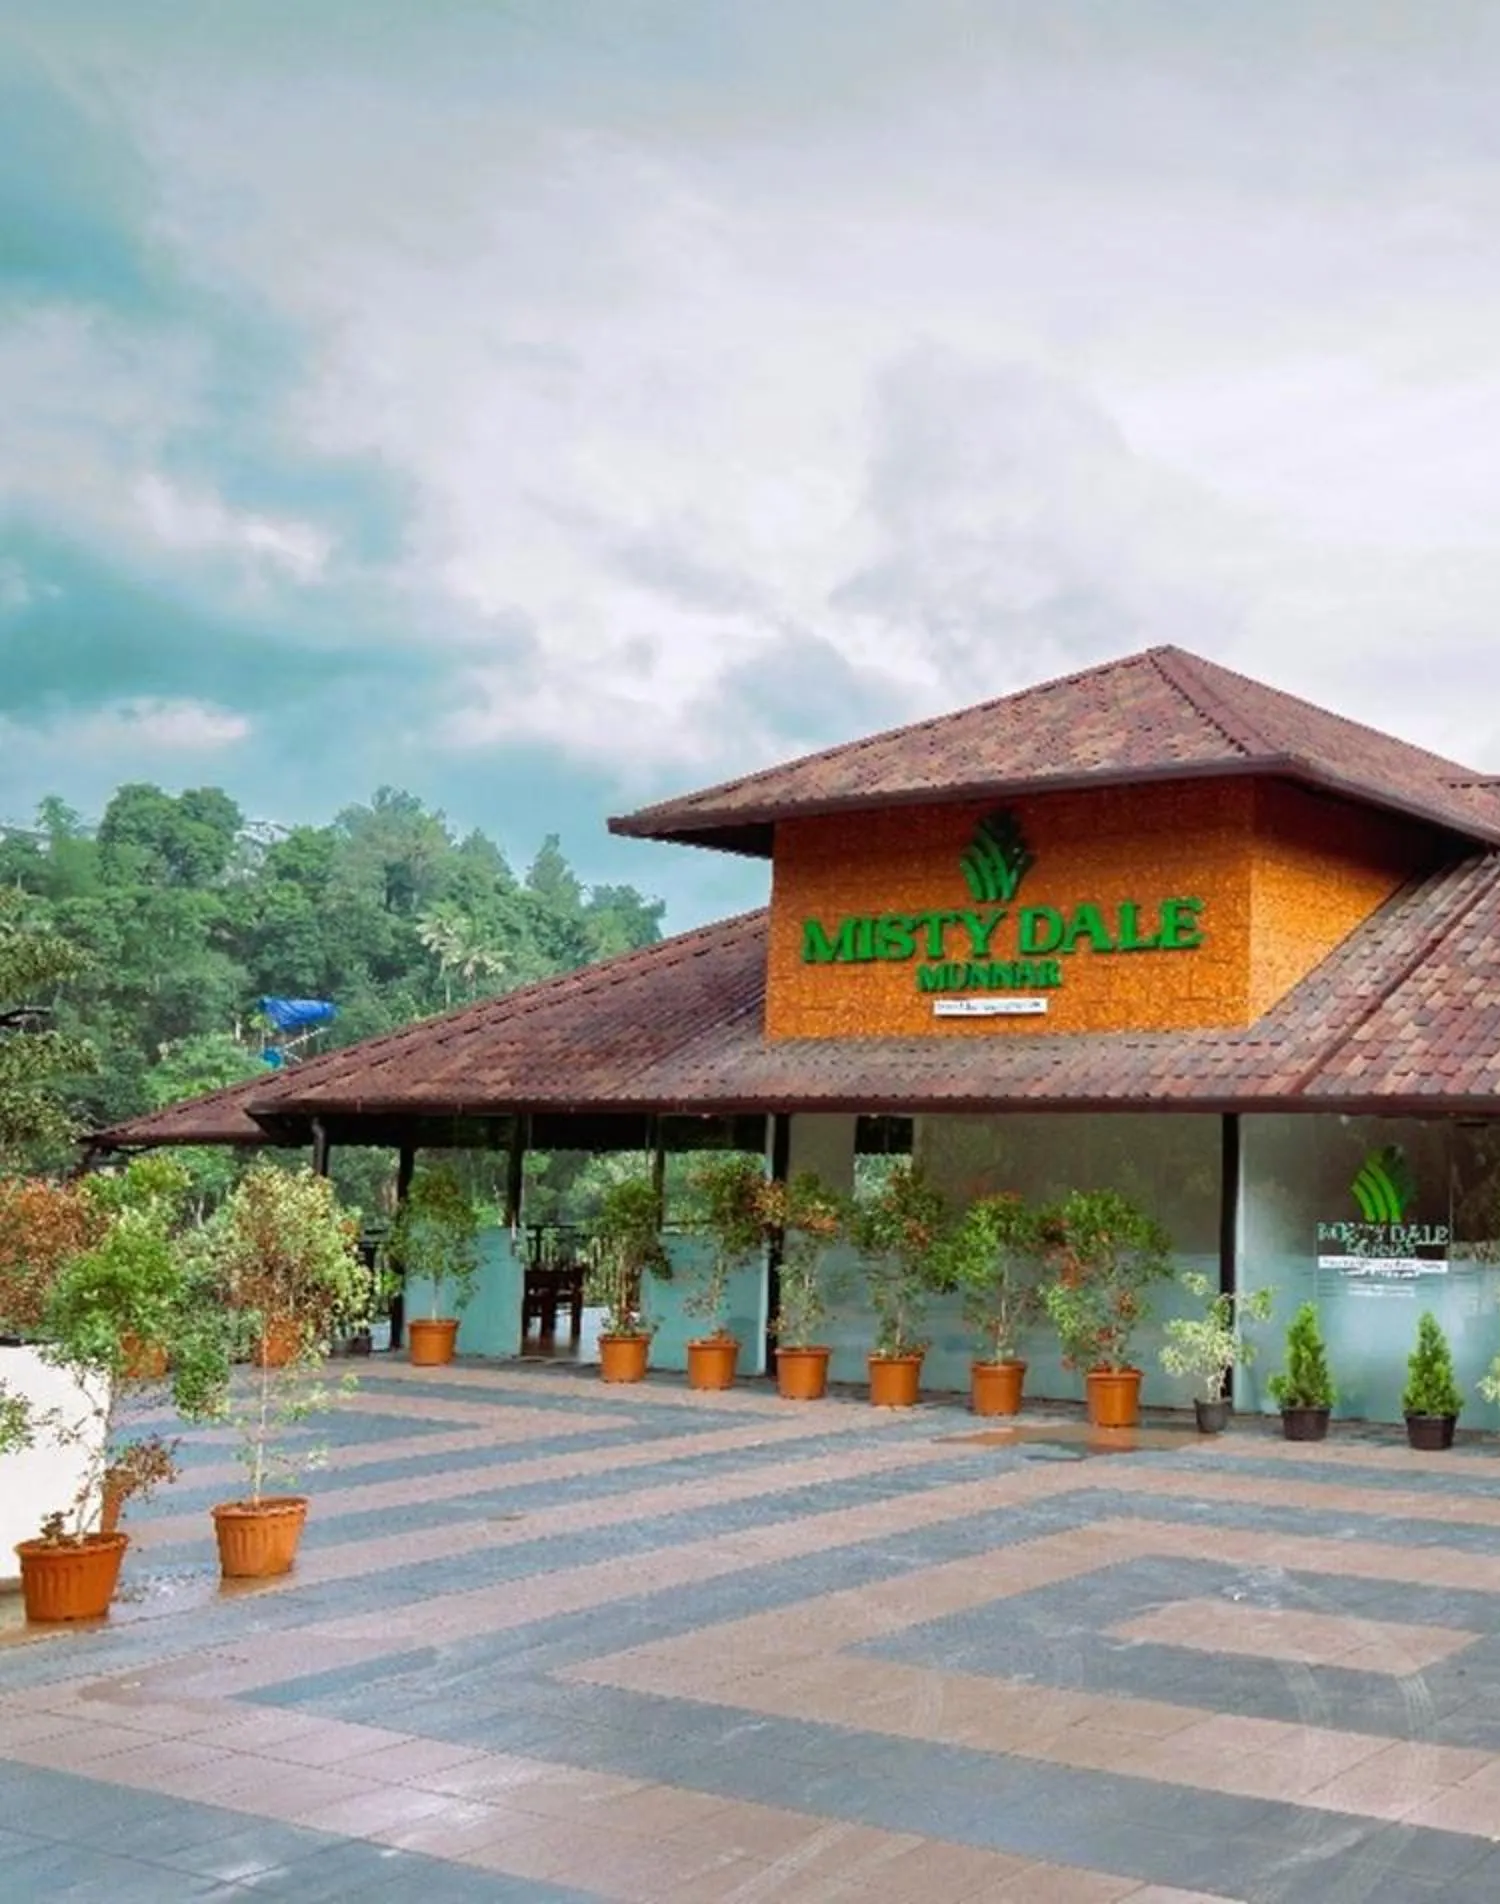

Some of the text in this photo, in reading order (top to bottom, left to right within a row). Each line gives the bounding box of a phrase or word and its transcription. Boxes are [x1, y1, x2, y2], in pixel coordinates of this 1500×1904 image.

[803, 896, 1204, 963] MISTY DALE
[916, 959, 1062, 992] MUNNAR
